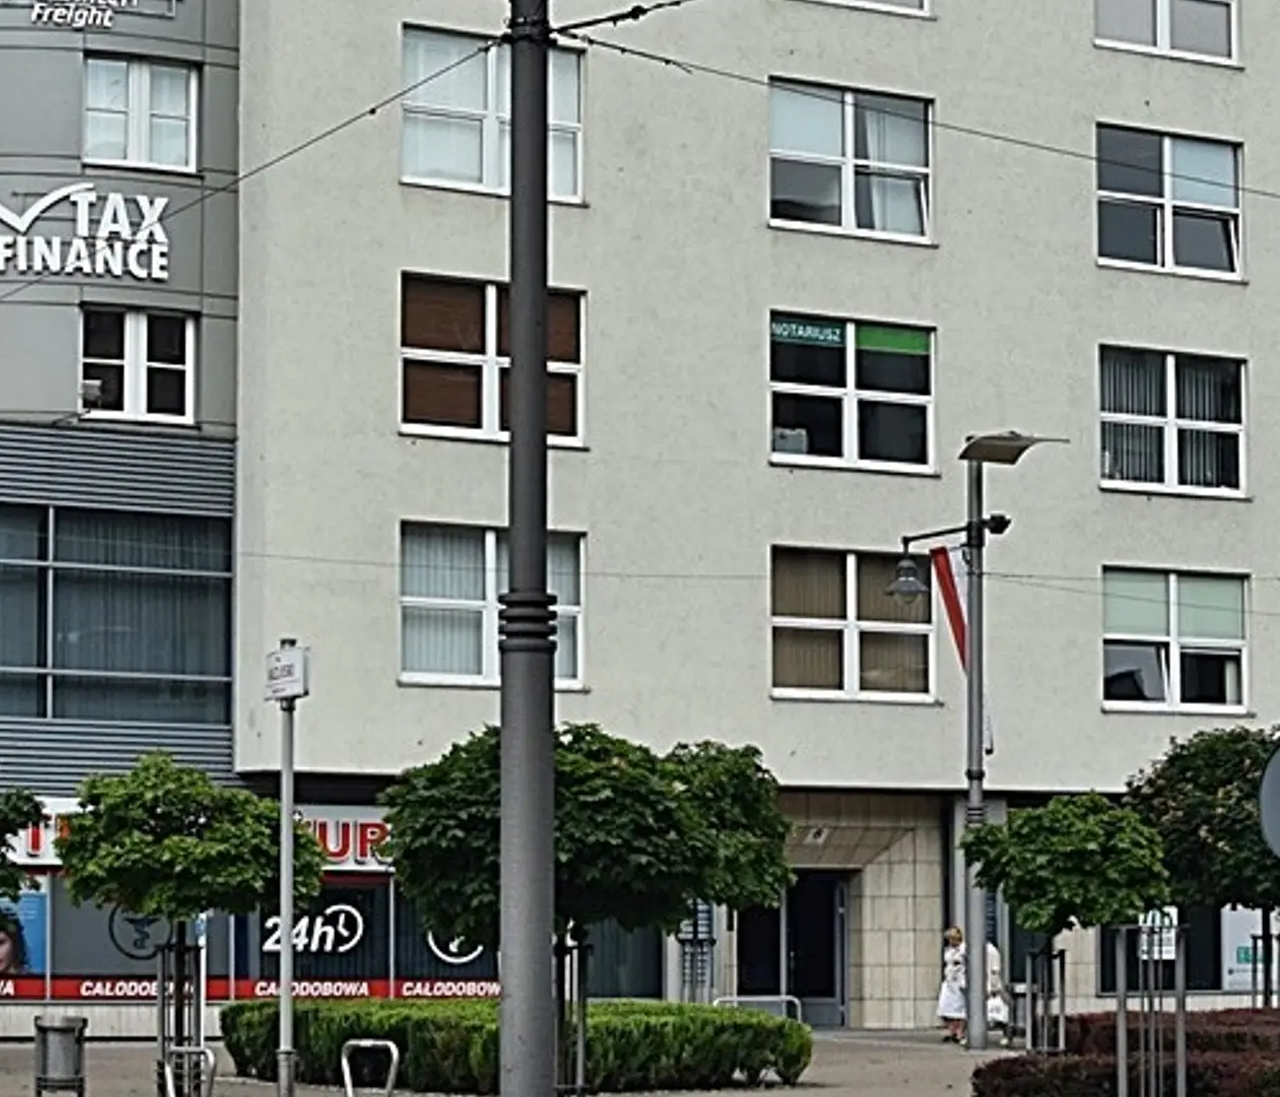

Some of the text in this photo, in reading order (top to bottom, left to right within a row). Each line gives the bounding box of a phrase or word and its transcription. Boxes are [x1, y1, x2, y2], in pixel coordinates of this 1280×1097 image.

[31, 2, 114, 29] Freight
[70, 190, 170, 244] TAX
[771, 322, 842, 342] NOTARIUSZ
[261, 914, 336, 952] 24h
[80, 981, 195, 997] CAŁODO
[254, 981, 370, 997] CADOBOWA
[402, 981, 502, 997] CAŁODOBOW
